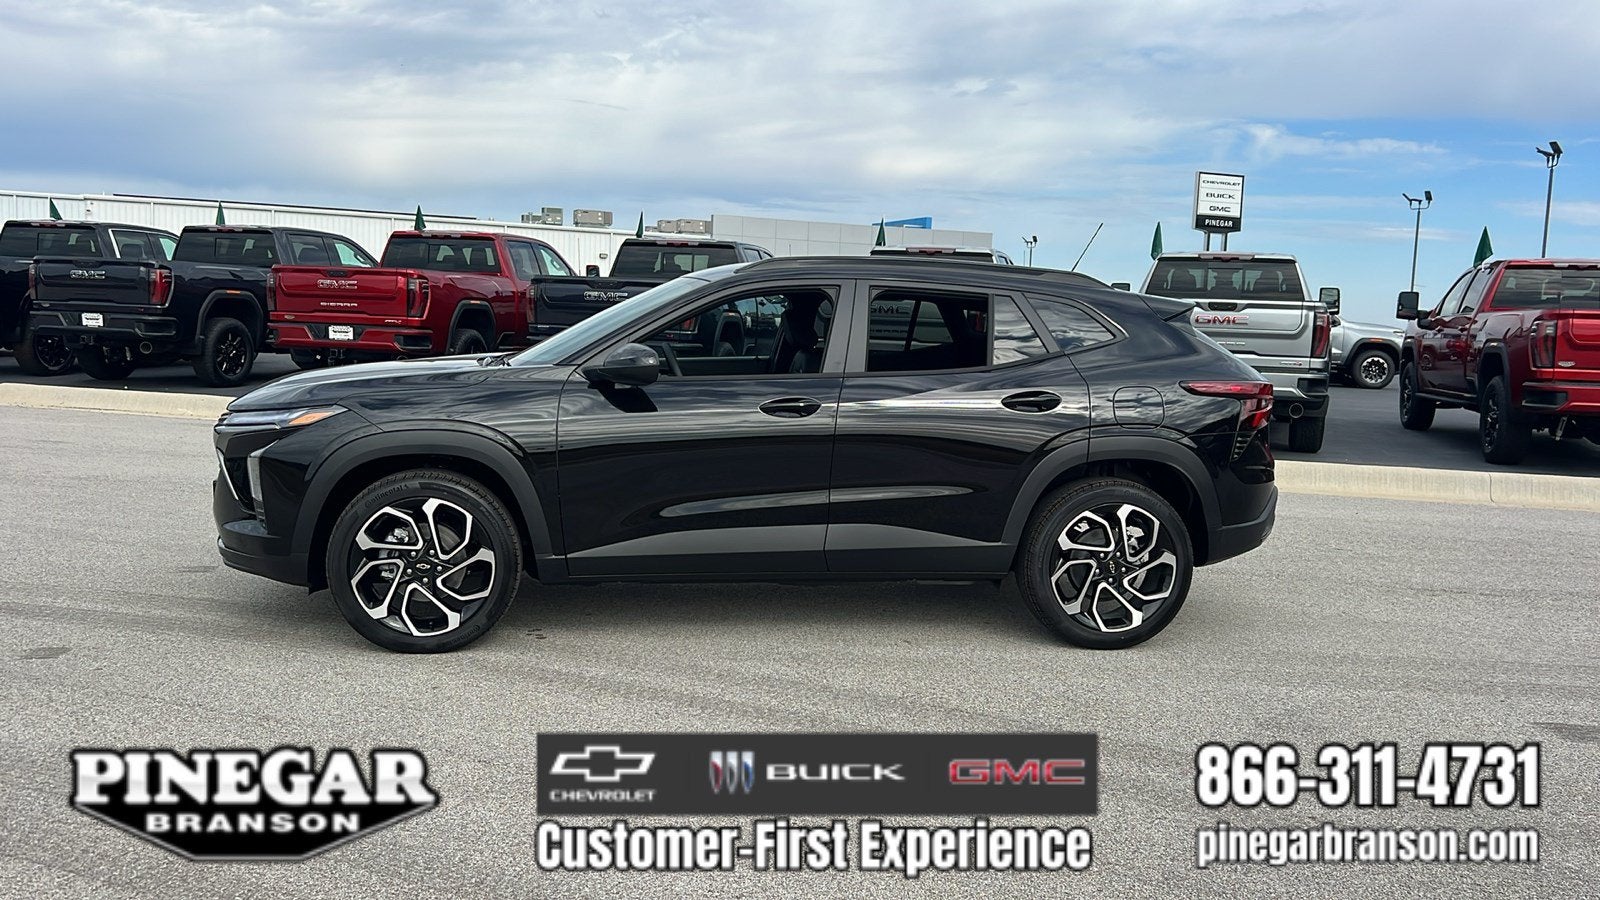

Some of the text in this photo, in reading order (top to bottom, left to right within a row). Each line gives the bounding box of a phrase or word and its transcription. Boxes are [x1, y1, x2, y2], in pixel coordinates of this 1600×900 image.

[1209, 205, 1231, 213] GMC
[1204, 219, 1233, 227] PINEGAR
[70, 269, 106, 279] GMC
[317, 279, 358, 289] GMC
[583, 290, 629, 301] GMC
[1194, 314, 1249, 325] GMC
